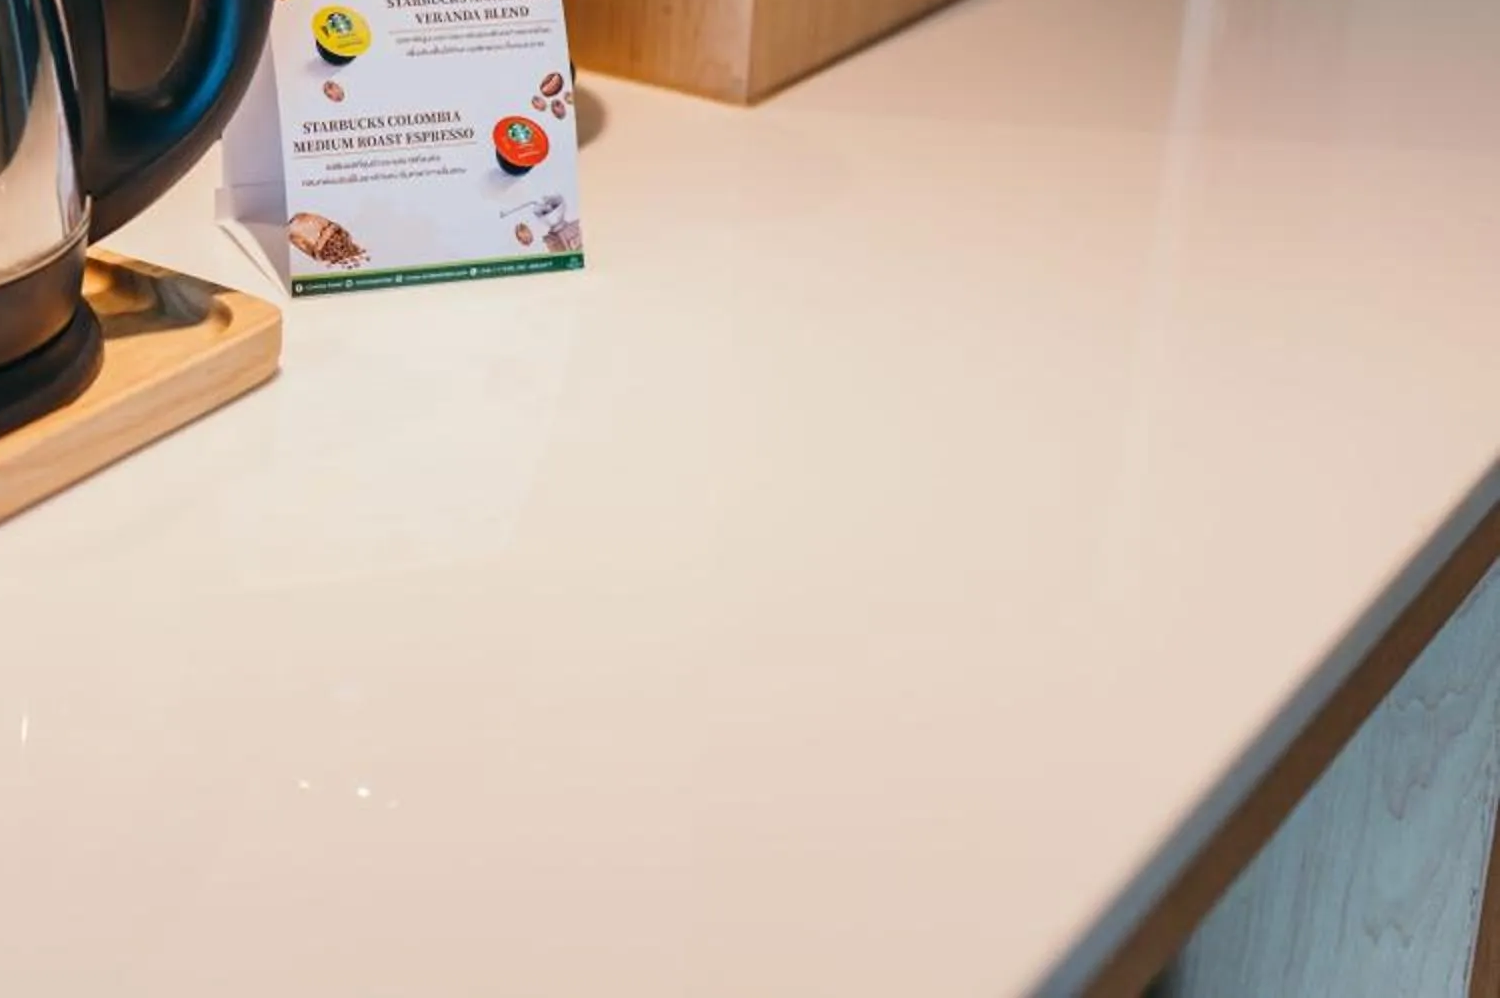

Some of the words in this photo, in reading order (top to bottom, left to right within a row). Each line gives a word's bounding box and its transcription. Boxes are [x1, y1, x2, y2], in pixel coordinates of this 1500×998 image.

[415, 9, 482, 25] VERANDA
[484, 5, 530, 20] BLEND
[302, 116, 385, 135] STARBUCKS
[387, 110, 462, 126] COLOMBIA
[293, 137, 354, 153] MEDIUM
[357, 132, 403, 149] ROAST
[406, 127, 475, 145] ESPRESSO
